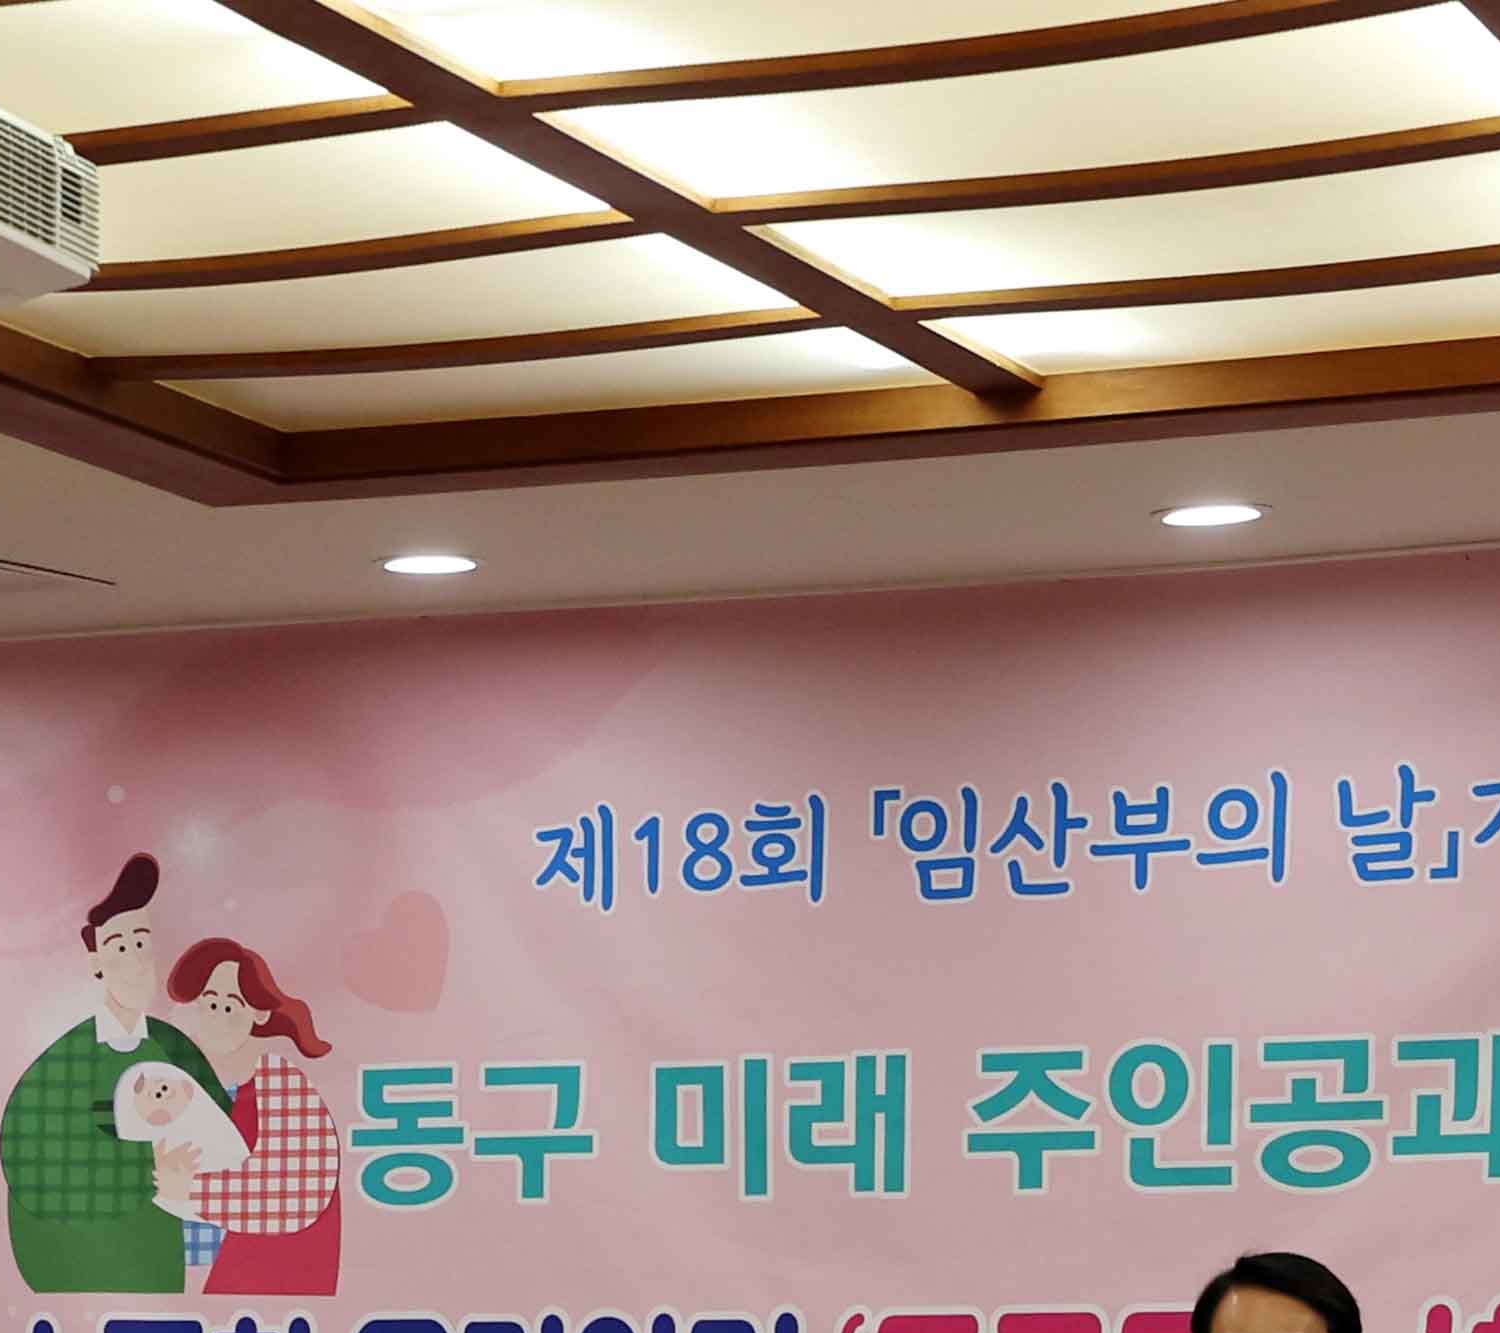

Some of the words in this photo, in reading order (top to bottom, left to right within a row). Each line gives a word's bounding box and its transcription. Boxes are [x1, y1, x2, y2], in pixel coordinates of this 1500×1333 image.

[535, 794, 825, 911] 제18회
[351, 1064, 594, 1205] 동구
[654, 1054, 907, 1196] 미래
